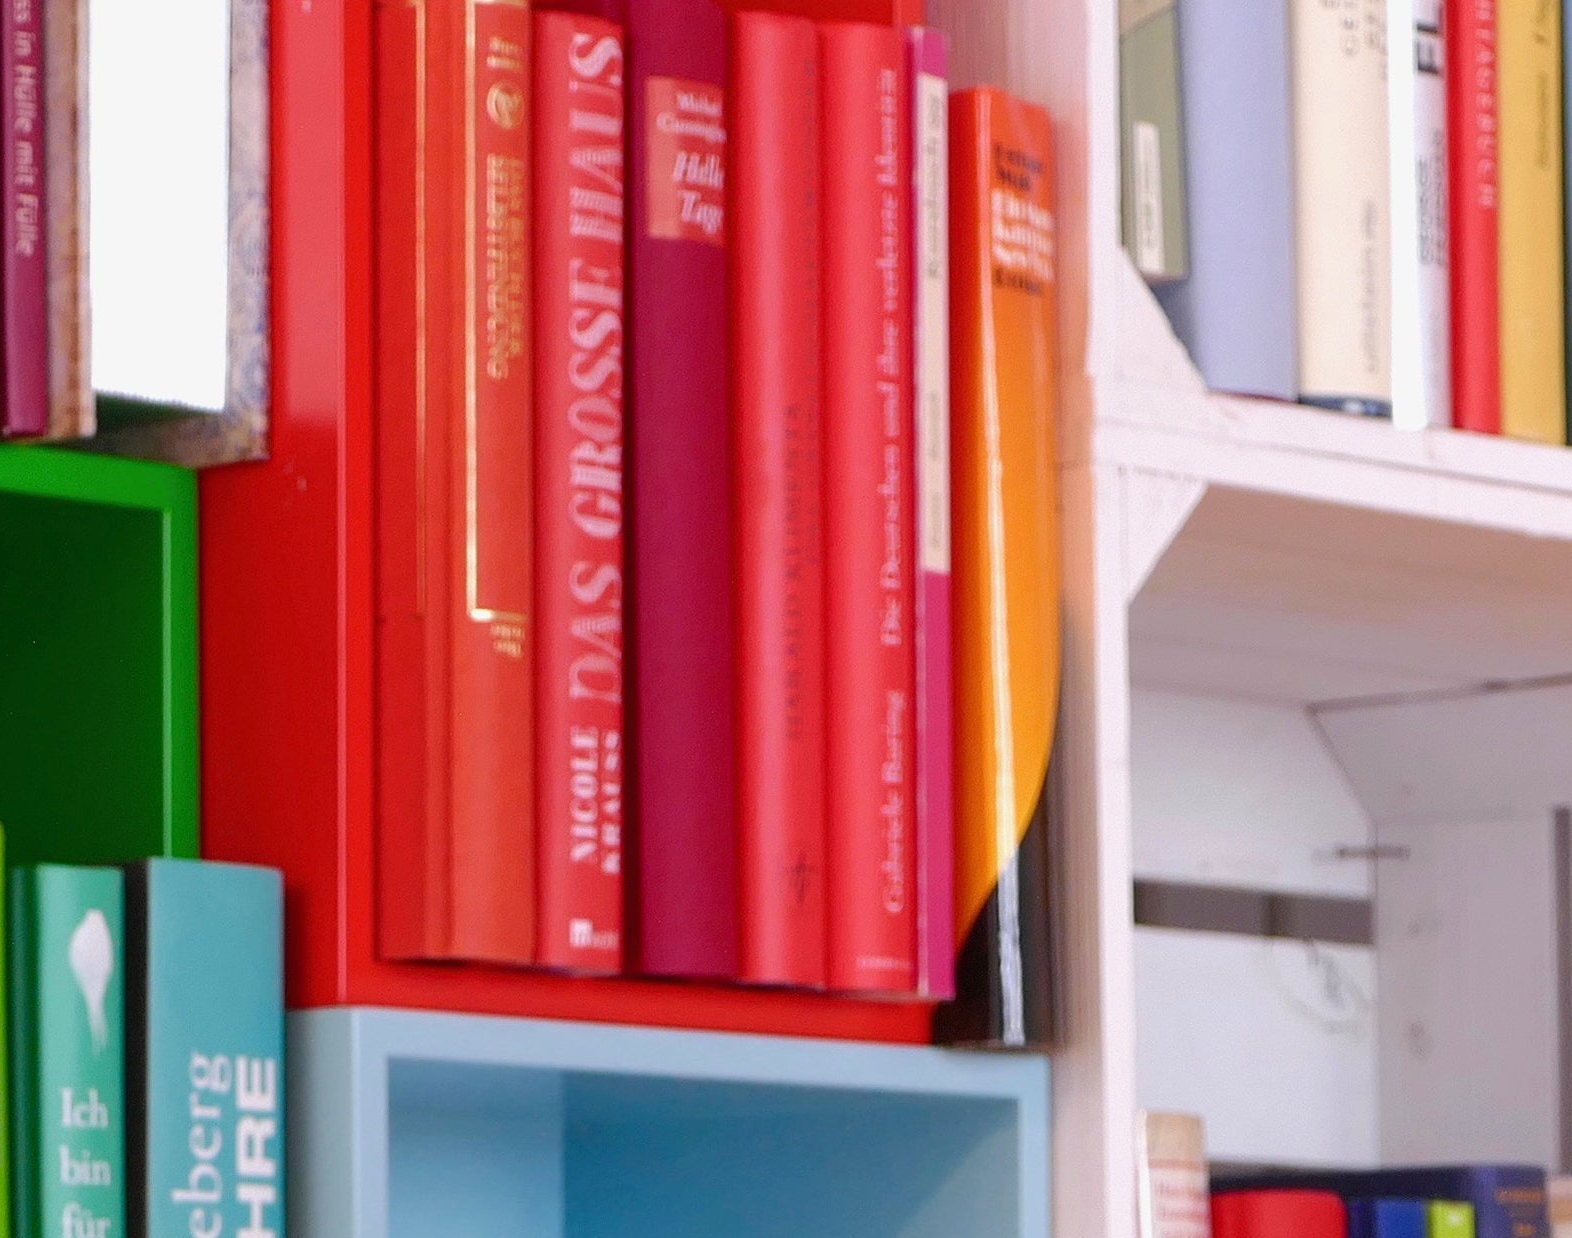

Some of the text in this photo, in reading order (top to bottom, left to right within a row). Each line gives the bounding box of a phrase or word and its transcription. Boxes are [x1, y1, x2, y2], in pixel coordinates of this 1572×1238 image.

[15, 140, 35, 188] mit
[567, 258, 622, 541] GROSSE
[568, 560, 622, 704] DAS
[570, 725, 599, 864] NICOLE
[60, 1087, 109, 1130] Ich
[59, 1145, 112, 1187] bin
